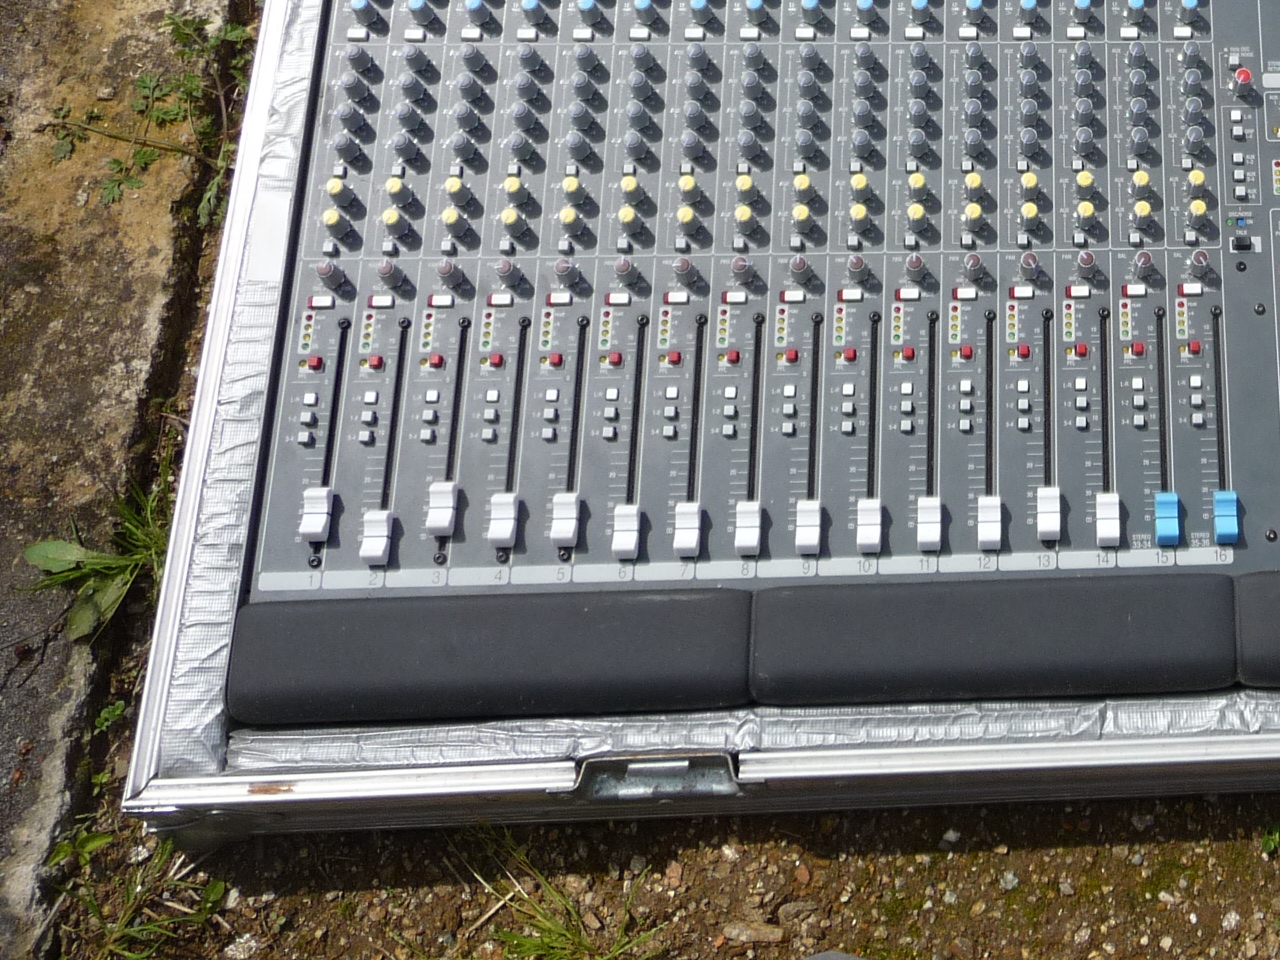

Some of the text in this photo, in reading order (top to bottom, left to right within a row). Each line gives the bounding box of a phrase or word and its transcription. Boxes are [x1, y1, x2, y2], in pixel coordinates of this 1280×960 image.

[1037, 554, 1050, 568] 13
[1095, 553, 1110, 567] 14
[1156, 551, 1168, 564] 15
[1214, 549, 1227, 562] 16
[740, 562, 749, 576] 8
[802, 561, 812, 574] 9
[857, 559, 871, 573] 10
[919, 558, 930, 571] 11
[977, 556, 991, 569] 12
[431, 570, 441, 585] 3
[494, 569, 503, 583] 4
[556, 568, 565, 581] 5
[618, 566, 627, 580] 6
[680, 566, 688, 578] 7
[308, 574, 314, 586] 1
[368, 572, 378, 586] 2
